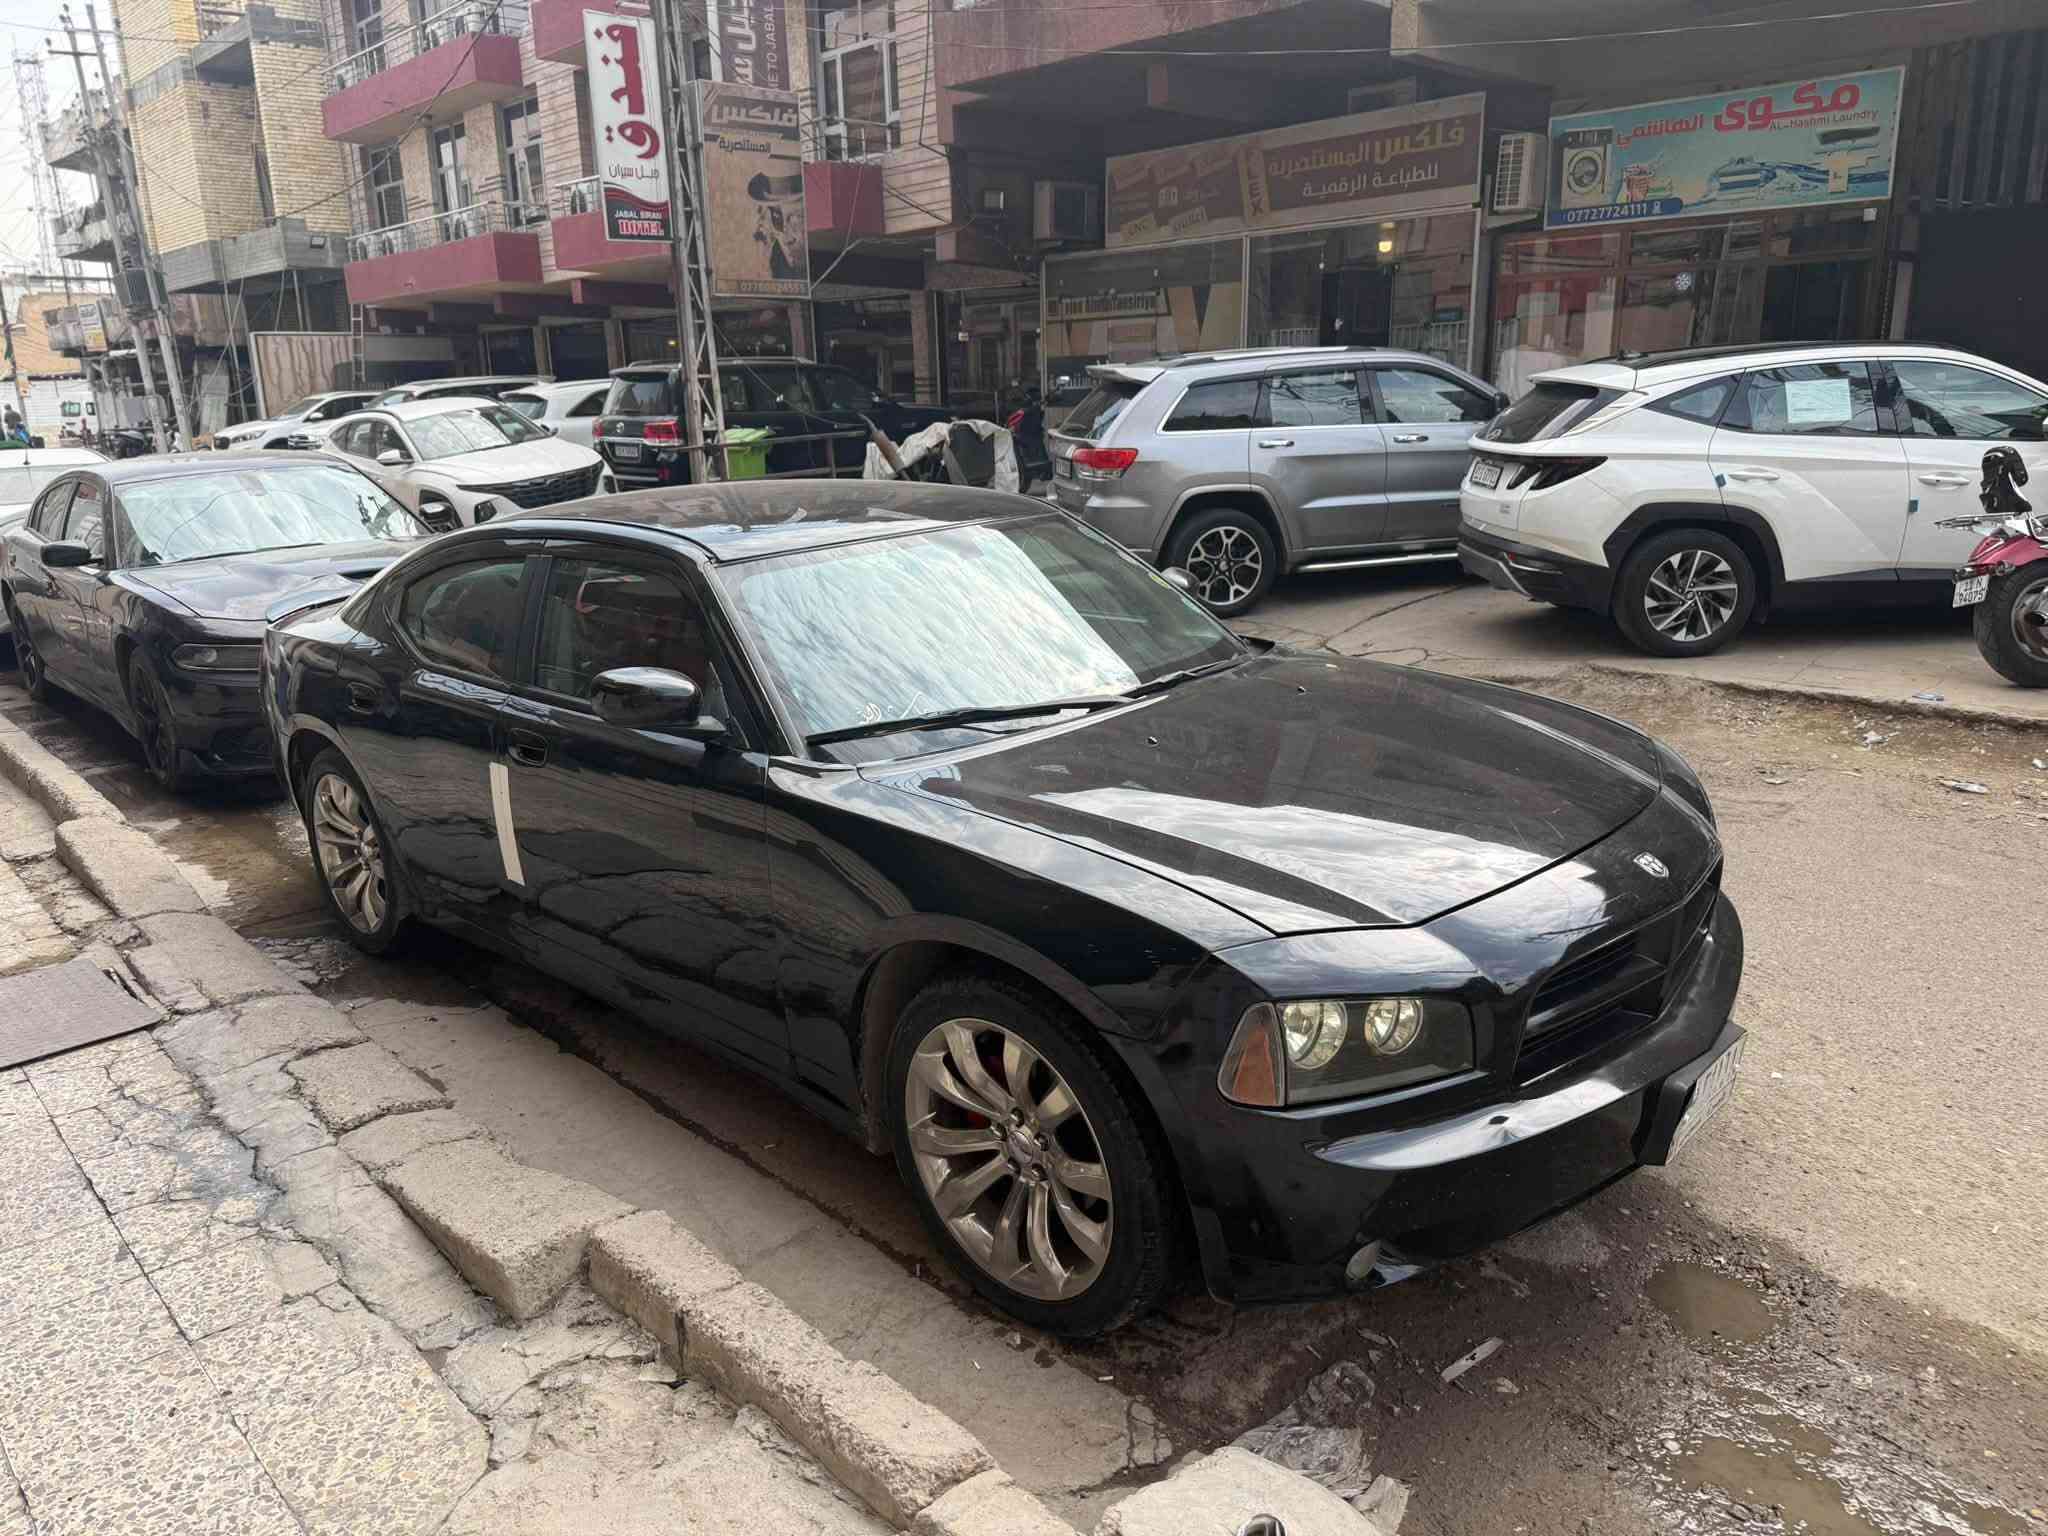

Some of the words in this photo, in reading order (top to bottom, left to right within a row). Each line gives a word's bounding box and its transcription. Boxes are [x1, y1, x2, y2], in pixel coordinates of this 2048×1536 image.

[593, 23, 660, 160] فندق
[711, 103, 797, 127] فلكس
[1832, 108, 1878, 124] Laundry
[608, 163, 634, 180] سيران
[635, 165, 660, 181] جبل
[1372, 161, 1439, 190] للطباعة
[1303, 170, 1367, 198] الرقمية
[614, 209, 639, 219] JABAL
[1567, 202, 1647, 224] 07727724111
